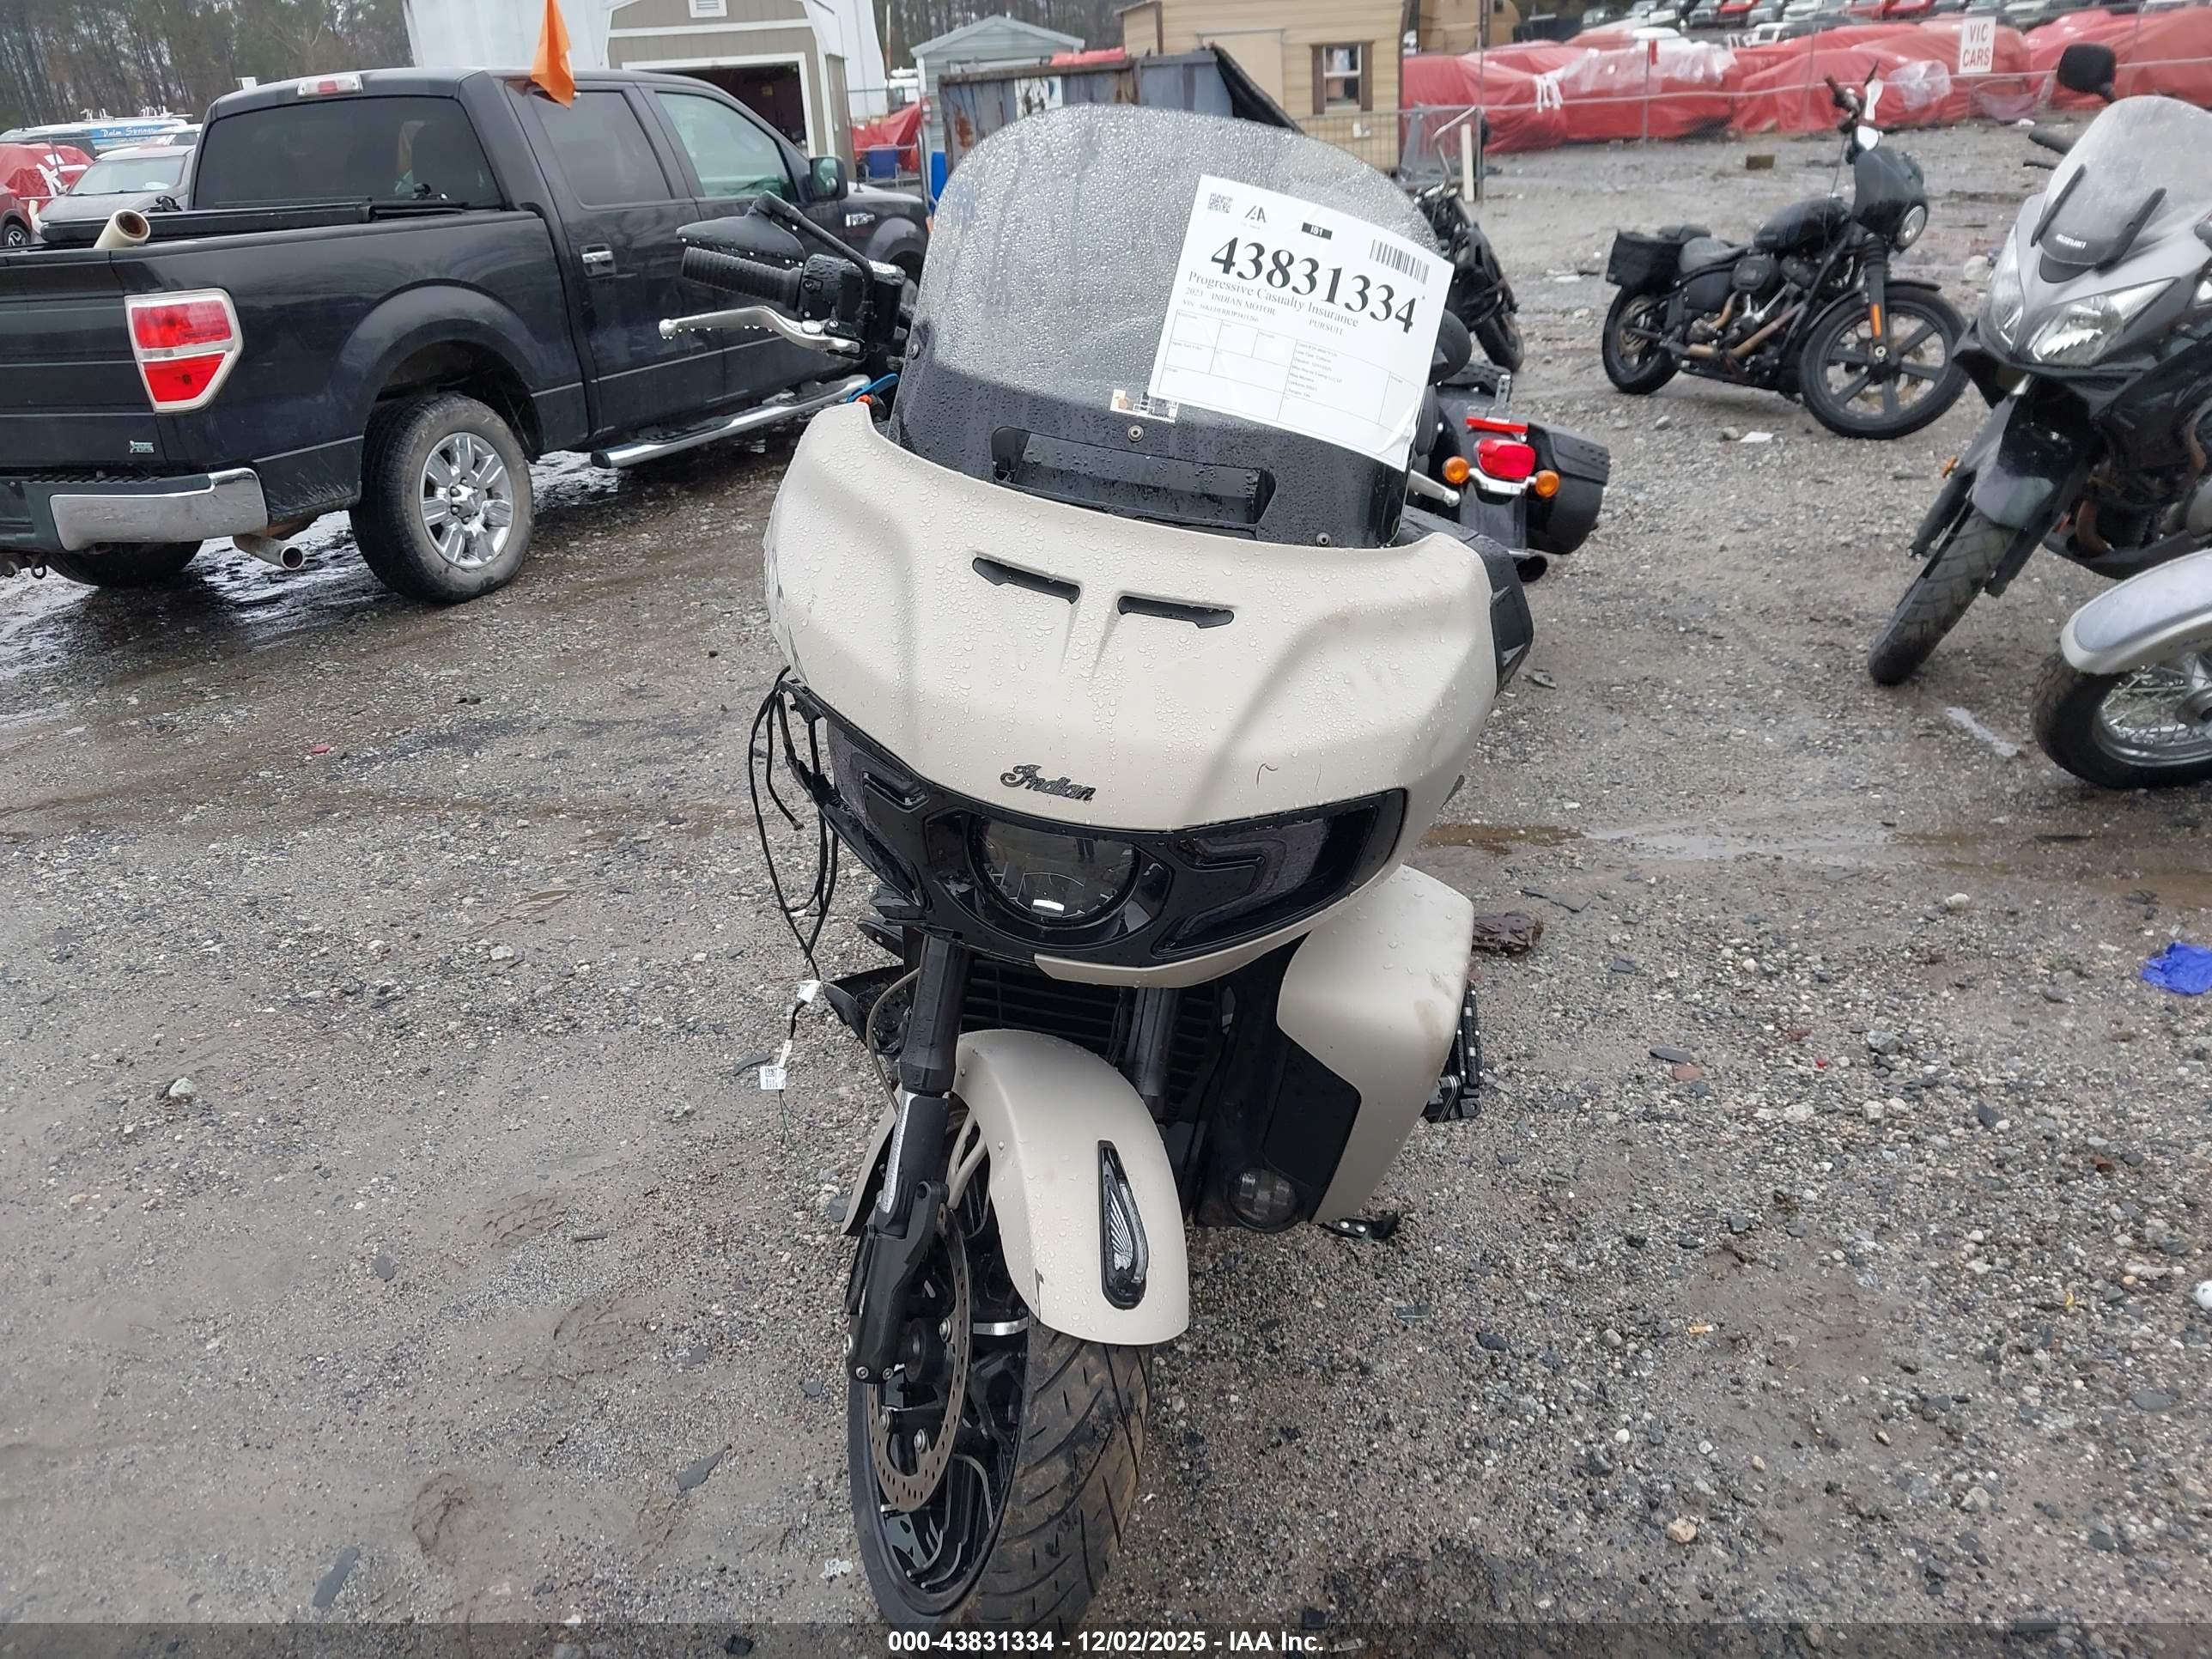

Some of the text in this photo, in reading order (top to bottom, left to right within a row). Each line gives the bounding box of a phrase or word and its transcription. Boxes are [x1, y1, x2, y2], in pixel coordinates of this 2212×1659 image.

[1970, 24, 1989, 42] VIC
[1963, 47, 1990, 67] CARS
[1211, 236, 1417, 334] 43831334
[1188, 270, 1359, 327] Progressive Casualty Insurance
[1212, 292, 1243, 307] INDIAN
[1244, 301, 1276, 316] MOTOR
[1309, 319, 1343, 336] PURSUIT
[1000, 764, 1097, 800] Indian
